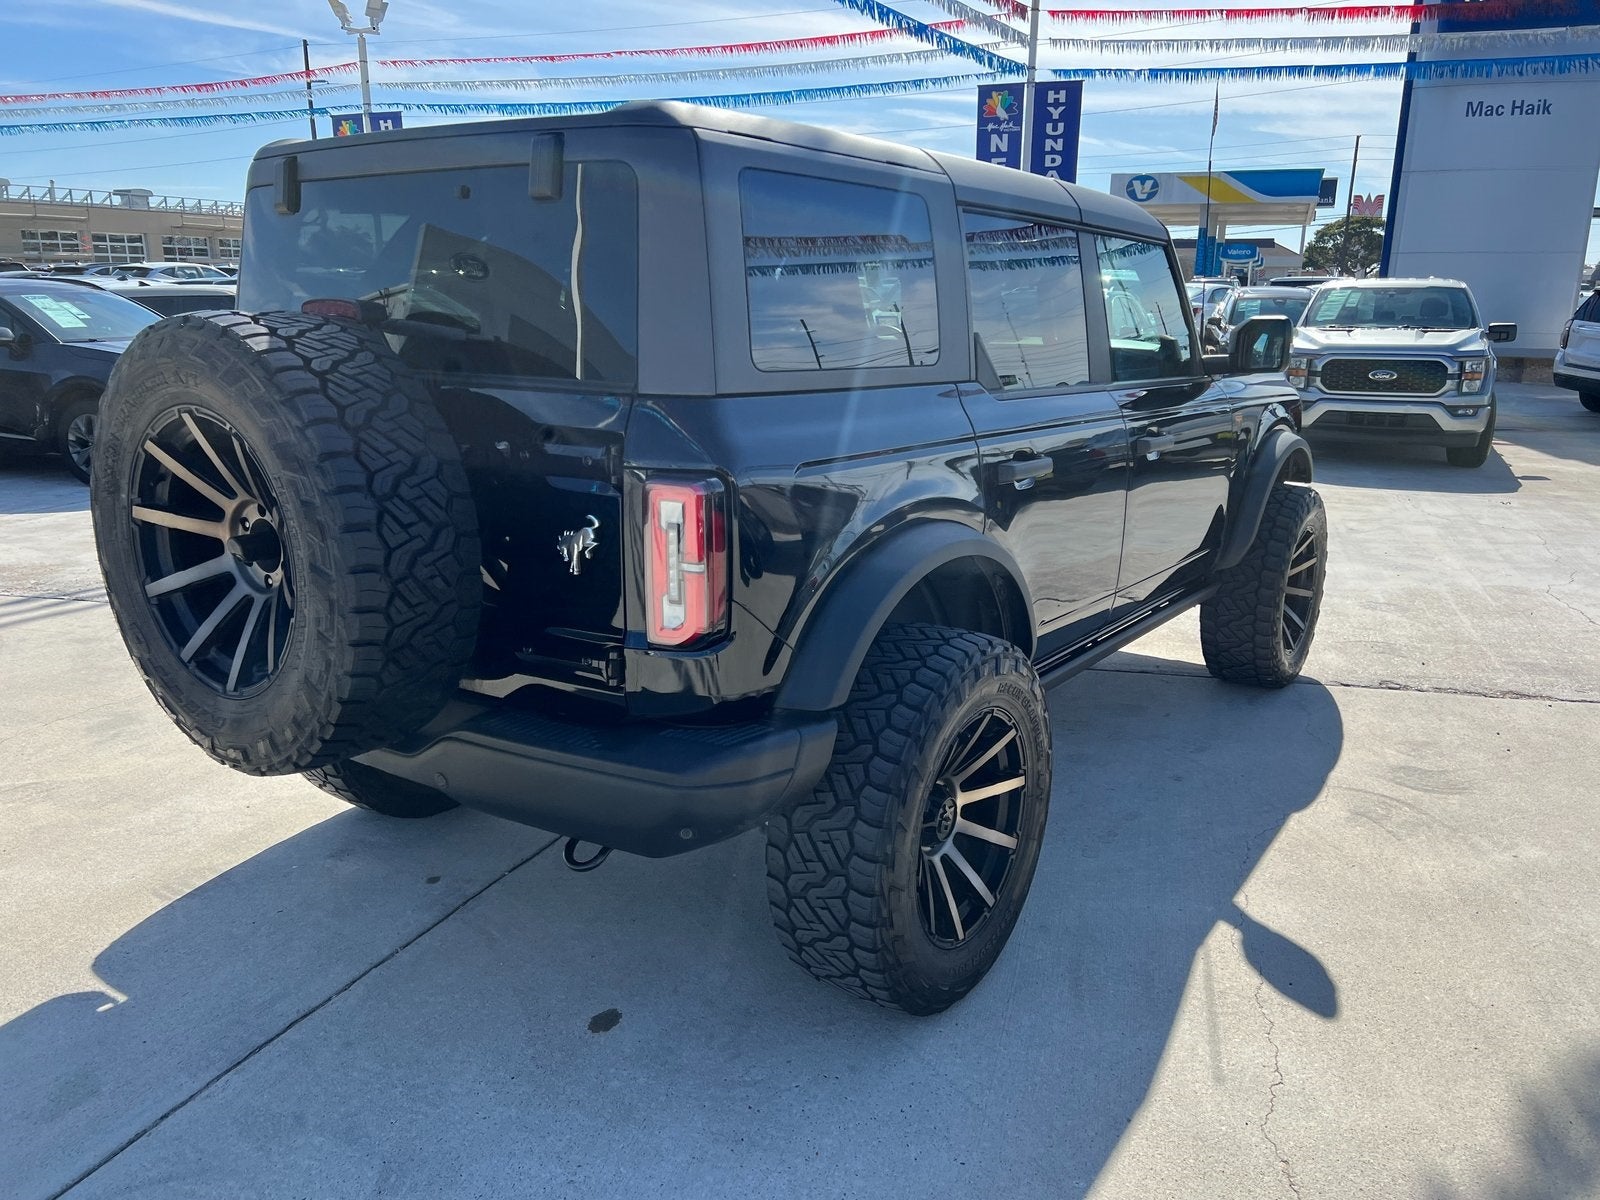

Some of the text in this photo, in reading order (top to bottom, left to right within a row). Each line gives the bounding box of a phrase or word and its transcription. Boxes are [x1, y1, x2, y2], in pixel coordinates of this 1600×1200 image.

[1465, 99, 1552, 117] Mac Haik
[1227, 248, 1251, 256] Valero
